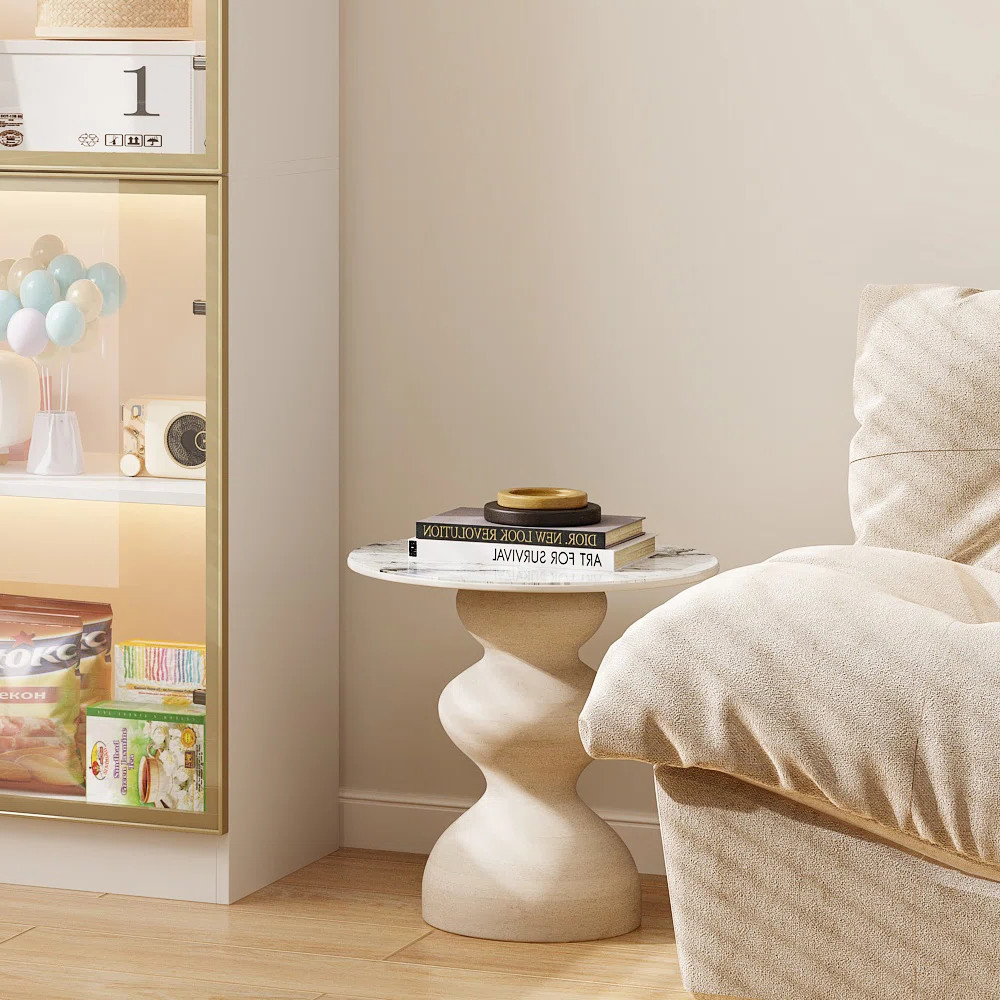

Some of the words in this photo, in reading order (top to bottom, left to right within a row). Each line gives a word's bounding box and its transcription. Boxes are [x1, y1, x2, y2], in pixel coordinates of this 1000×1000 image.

[123, 65, 160, 117] 1
[113, 740, 121, 779] Sindbad
[120, 727, 128, 762] Jasmine
[128, 754, 136, 770] Tea
[120, 762, 128, 796] Green
